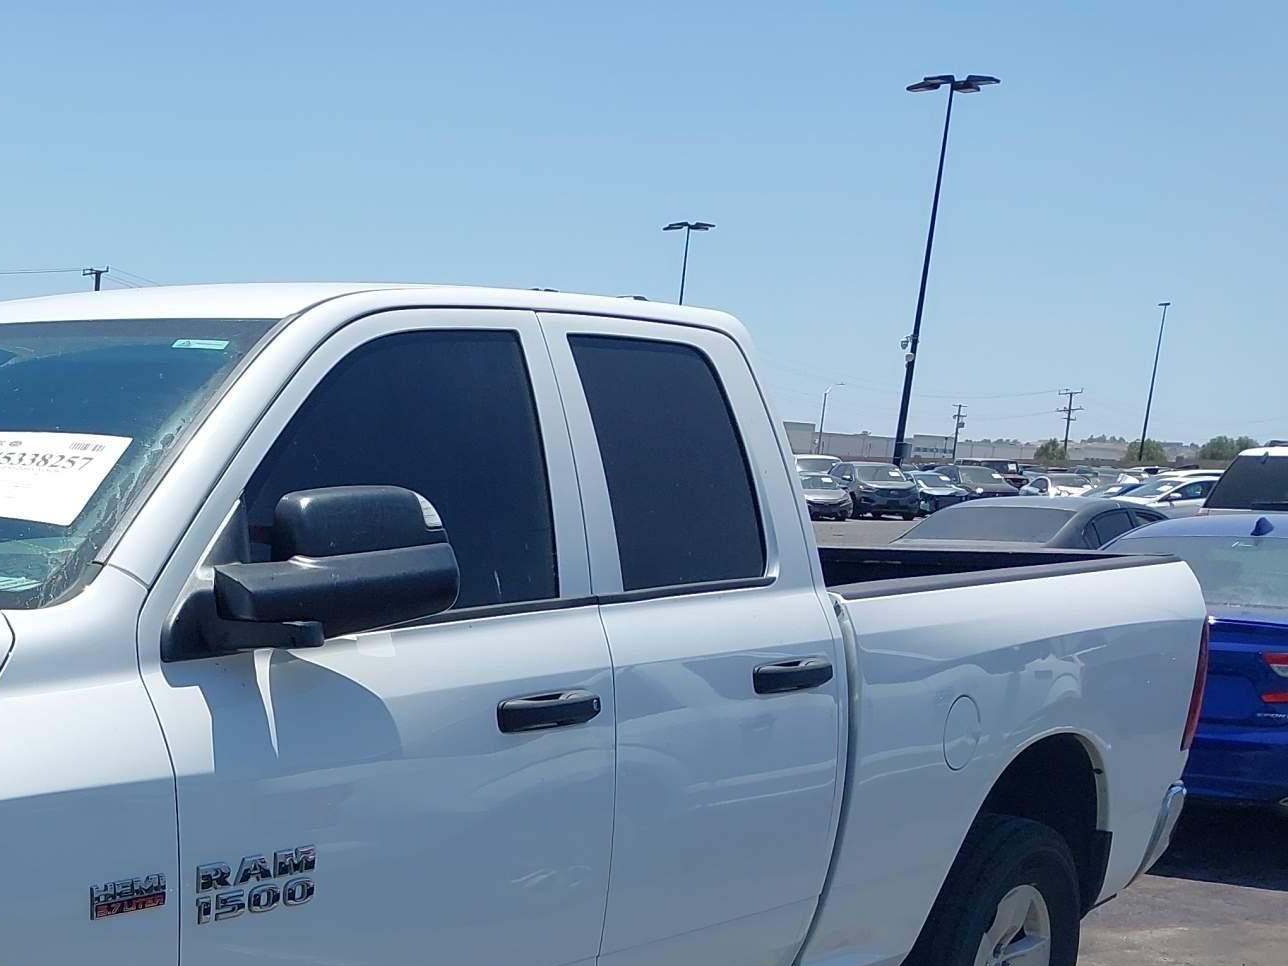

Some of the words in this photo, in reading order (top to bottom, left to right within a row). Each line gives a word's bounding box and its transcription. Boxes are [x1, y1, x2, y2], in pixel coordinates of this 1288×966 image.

[90, 873, 168, 903] HEMI
[196, 844, 316, 894] RAM
[196, 877, 315, 925] 1500
